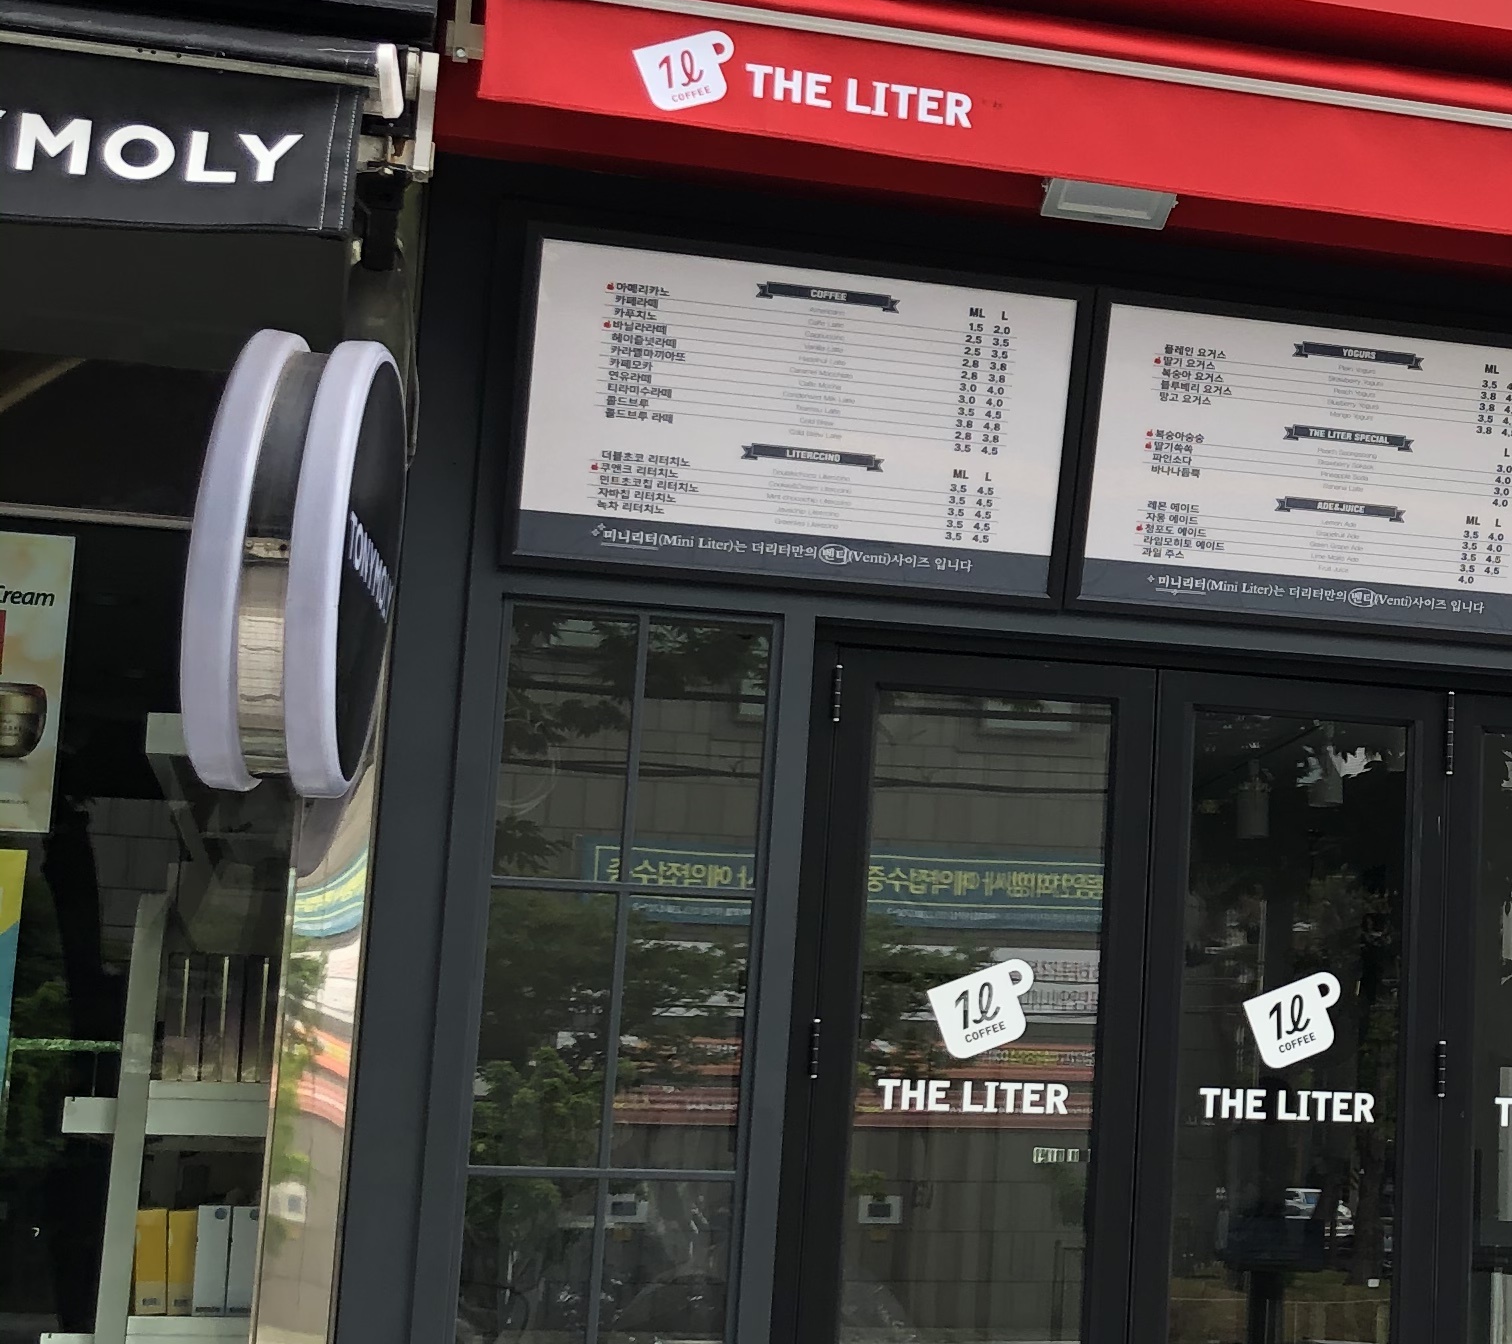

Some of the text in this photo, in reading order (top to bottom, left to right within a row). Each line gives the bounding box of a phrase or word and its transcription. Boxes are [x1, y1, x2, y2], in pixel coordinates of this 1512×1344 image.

[671, 85, 711, 104] COFFEE
[745, 62, 973, 129] THE LITER
[0, 110, 304, 184] MOLY
[615, 282, 671, 297] 아메리카노
[810, 288, 848, 301] COFFEE
[969, 307, 1008, 320] ML L
[969, 322, 1011, 335] 1.5 2.0
[965, 335, 1009, 347] 2.5 3.5
[962, 359, 1007, 372] 2.8 3.8
[1485, 364, 1499, 374] ML
[959, 383, 1004, 395] 3.0 4.0
[1482, 380, 1497, 389] 3.5
[1480, 391, 1496, 400] 3.8
[955, 419, 1000, 431] 3.8 4.8
[1309, 428, 1389, 444] THE LITER SPECIAL
[1504, 448, 1510, 457] L
[636, 466, 679, 478] 리터치노
[1496, 464, 1512, 473] 3.0
[953, 469, 992, 481] ML L
[1495, 476, 1511, 484] 4.0
[950, 484, 994, 495] 3.5 4.5
[634, 490, 676, 503] 리터치노
[1170, 502, 1200, 514] 에이드
[1316, 501, 1365, 514] ADE&JUICE
[1169, 514, 1198, 525] 에이드
[1466, 516, 1501, 527] ML L
[1177, 526, 1207, 537] 에이드
[1463, 530, 1504, 541] 3.5 4.0
[752, 541, 818, 558] 더리터만의
[935, 557, 973, 572] 입니다
[1289, 586, 1347, 602] 더리터만의
[1451, 601, 1485, 614] 입니다
[964, 1020, 1006, 1043] COFFEE
[1278, 1032, 1317, 1053] COFFEE
[877, 1078, 1069, 1115] THE LITER
[1199, 1087, 1375, 1123] THE LITER
